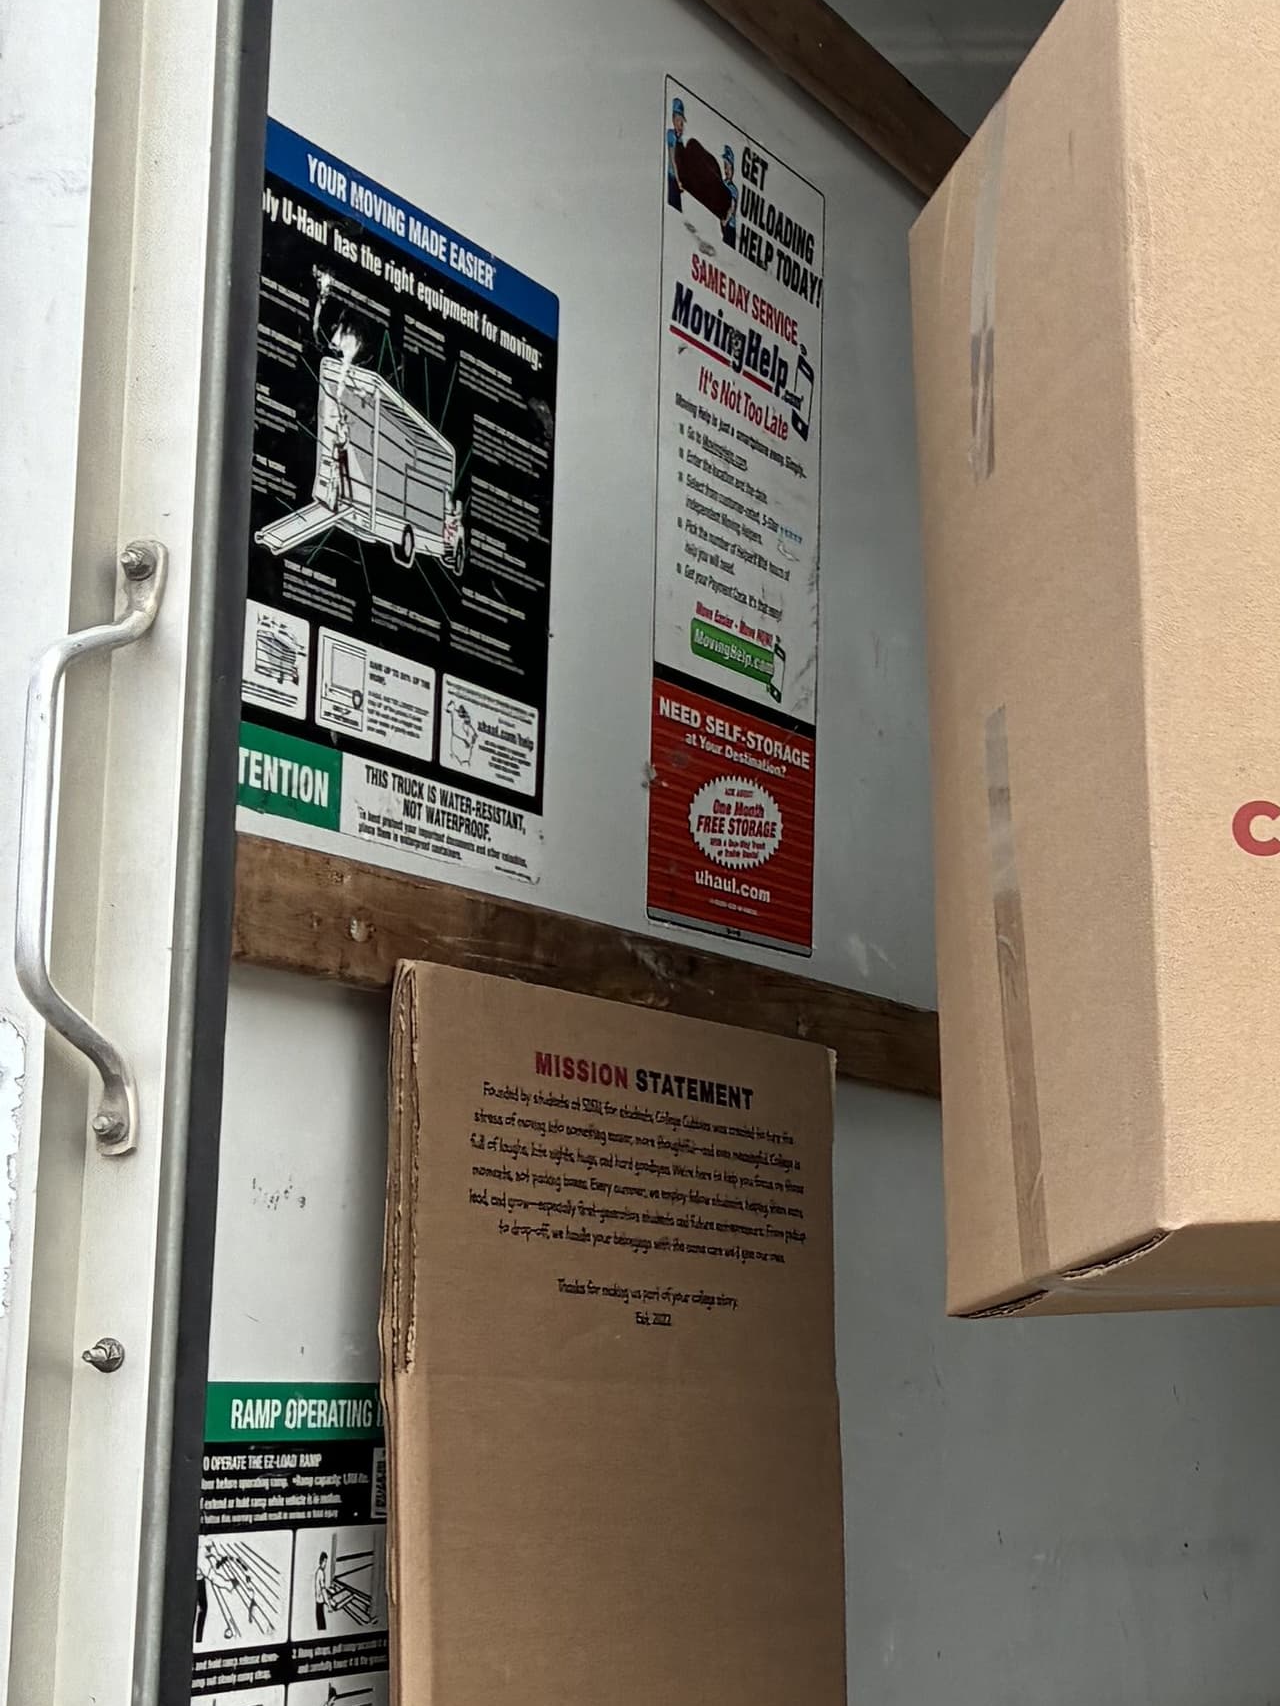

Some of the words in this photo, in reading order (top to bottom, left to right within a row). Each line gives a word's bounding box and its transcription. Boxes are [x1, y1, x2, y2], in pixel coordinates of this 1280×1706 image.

[741, 147, 768, 191] GET
[308, 154, 347, 203] YOUR
[350, 181, 405, 237] MOVING
[409, 217, 446, 263] MADE
[740, 193, 814, 266] UNLOADING
[334, 229, 358, 263] has
[361, 244, 382, 276] the
[384, 261, 414, 296] right
[417, 282, 479, 333] equipment
[481, 313, 498, 343] for
[739, 227, 772, 271] HELP
[776, 248, 823, 309] TODAY!
[691, 254, 727, 298] SAME
[728, 280, 750, 314] DAY
[751, 297, 798, 346] SERVICE
[698, 365, 718, 401] It's
[719, 379, 742, 414] Not
[744, 392, 763, 426] Too
[764, 405, 789, 440] Late
[659, 695, 700, 728] NEED
[706, 715, 810, 770] SELF-STORAGE
[685, 733, 697, 745] at
[699, 735, 722, 756] Your
[724, 745, 787, 777] Destination?
[365, 765, 388, 789] THIS
[392, 773, 424, 800] TRUCK
[428, 785, 436, 803] IS
[440, 788, 526, 835] WATER-RESISTANT,
[403, 799, 422, 821] NOT
[426, 805, 491, 842] WATERPROOF.
[713, 799, 731, 815] One
[735, 802, 764, 818] Month
[696, 815, 725, 834] FREE
[728, 818, 777, 838] STORAGE
[696, 870, 770, 903] uhaul.com
[483, 1081, 518, 1101] Founded
[520, 1088, 530, 1107] by
[535, 1051, 628, 1089] MISSION
[636, 1068, 754, 1111] STATEMENT
[474, 1109, 503, 1125] stress
[231, 1399, 281, 1429] RAMP
[285, 1399, 373, 1429] OPERATING
[211, 1456, 246, 1471] OPERATE
[249, 1455, 263, 1469] THE
[264, 1454, 297, 1469] EZ-LOAD
[300, 1454, 322, 1468] RAMP
